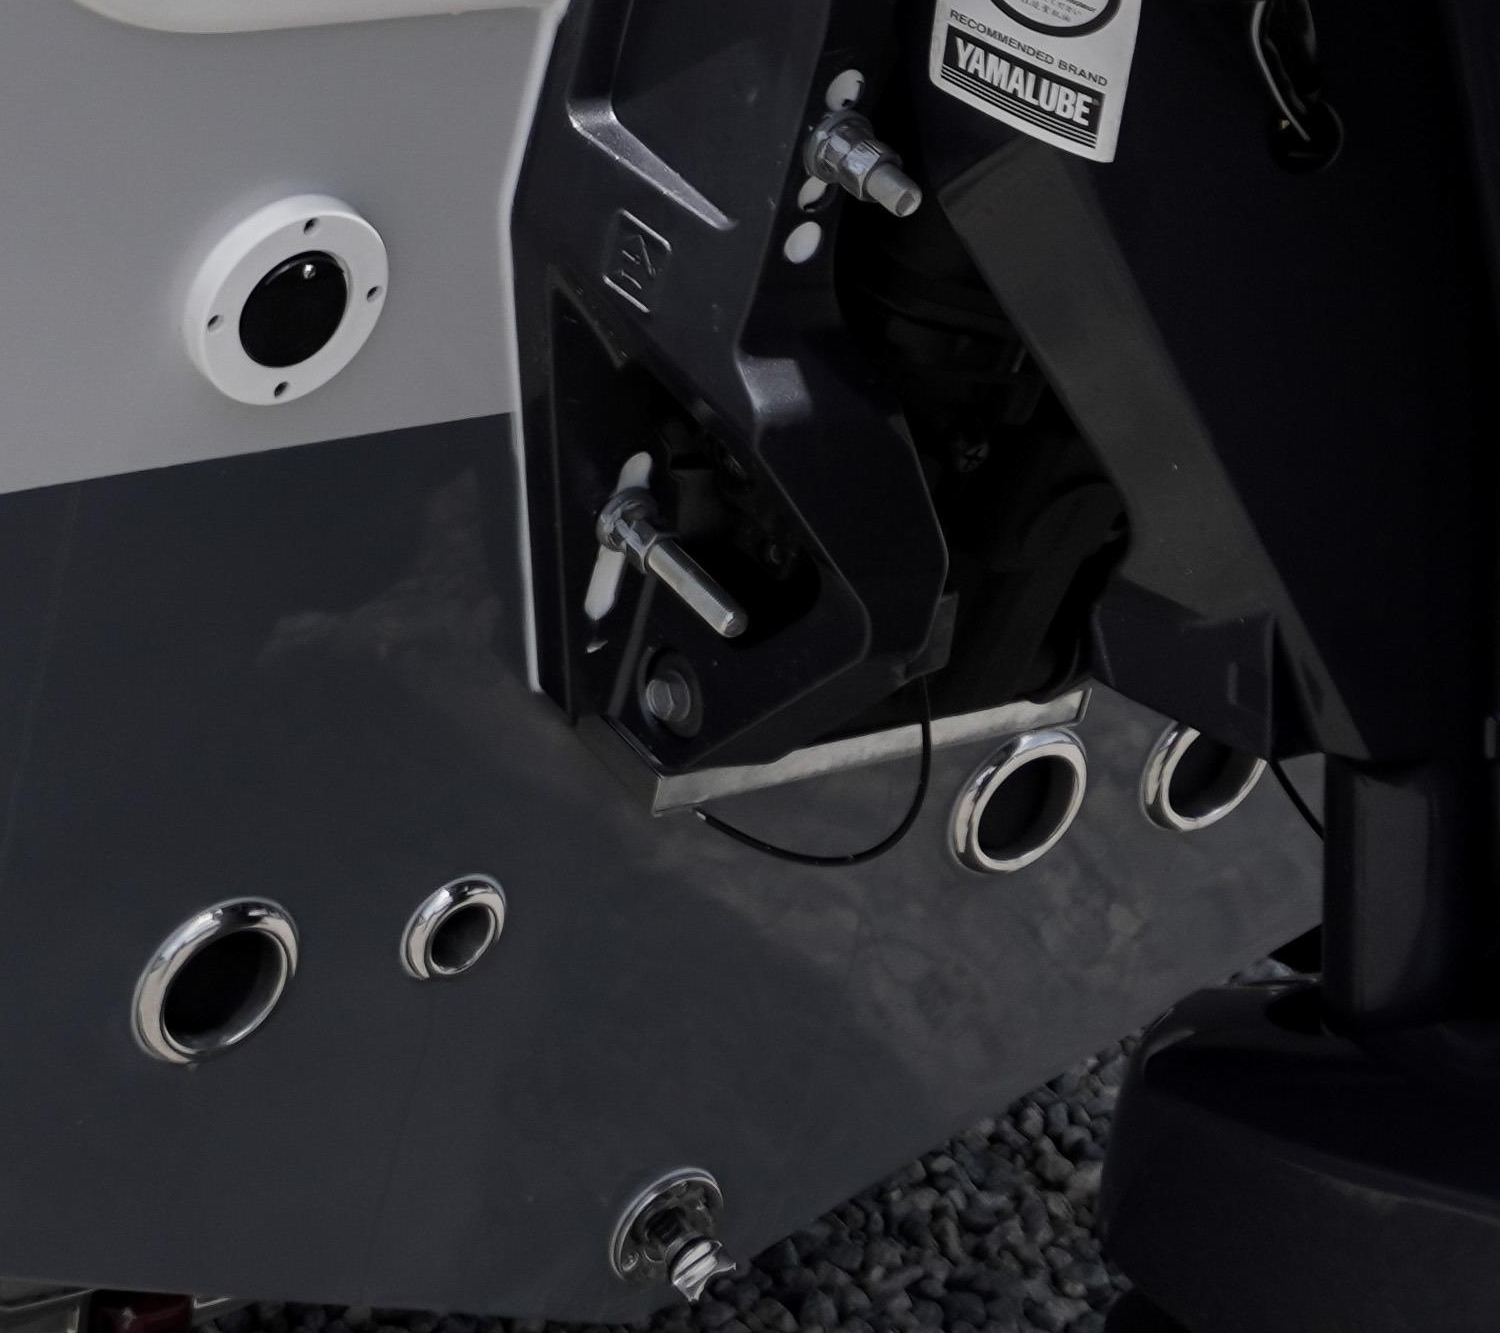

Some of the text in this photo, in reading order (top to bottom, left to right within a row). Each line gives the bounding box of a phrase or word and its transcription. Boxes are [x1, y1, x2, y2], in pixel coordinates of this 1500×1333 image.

[949, 9, 1109, 87] RECOMMENDED BRAND
[955, 35, 1094, 126] YAMALUBE
